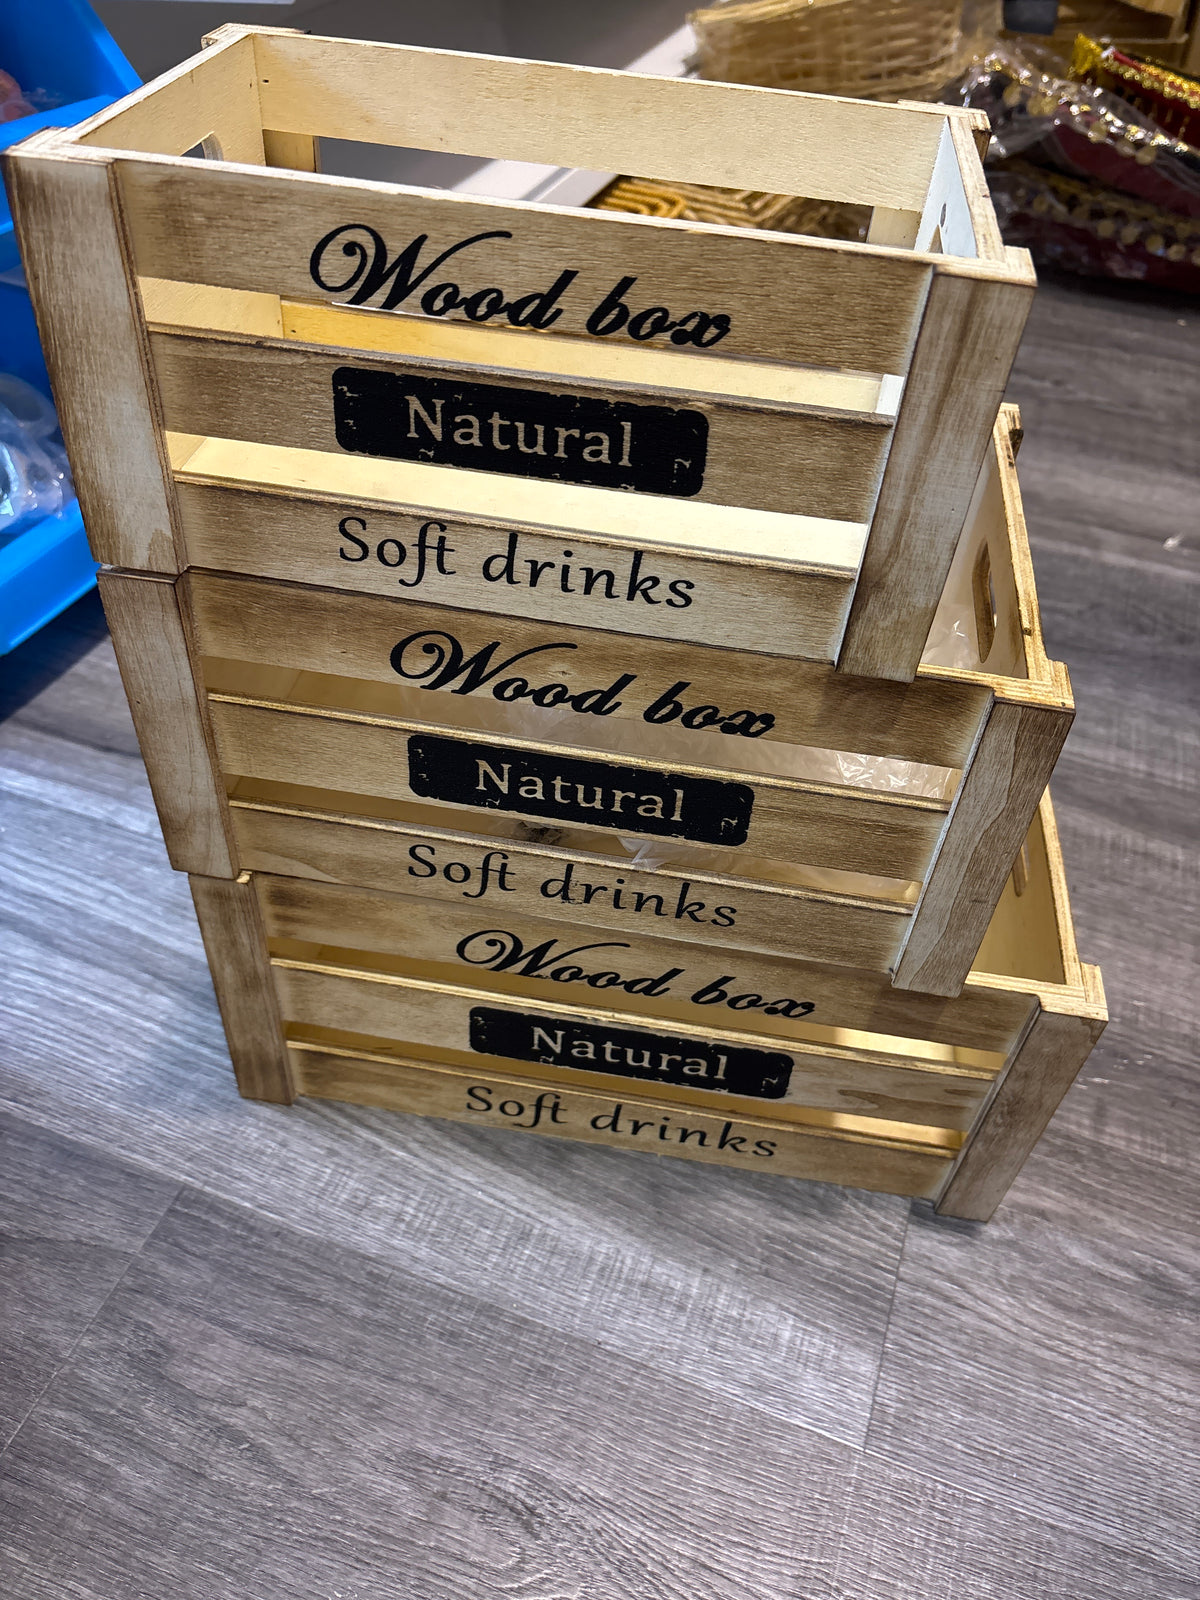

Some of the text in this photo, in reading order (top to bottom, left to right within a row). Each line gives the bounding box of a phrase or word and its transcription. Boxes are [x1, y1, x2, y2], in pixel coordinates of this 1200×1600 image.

[310, 224, 731, 348] Wood box
[404, 395, 633, 467] Natural
[338, 516, 695, 608] Soft drinks
[390, 630, 775, 738] Wood box
[475, 760, 683, 822] Natural
[408, 844, 738, 927] Soft drinks
[456, 930, 815, 1018] Wood box
[531, 1027, 727, 1079] Natural
[466, 1086, 777, 1157] Soft drinks
